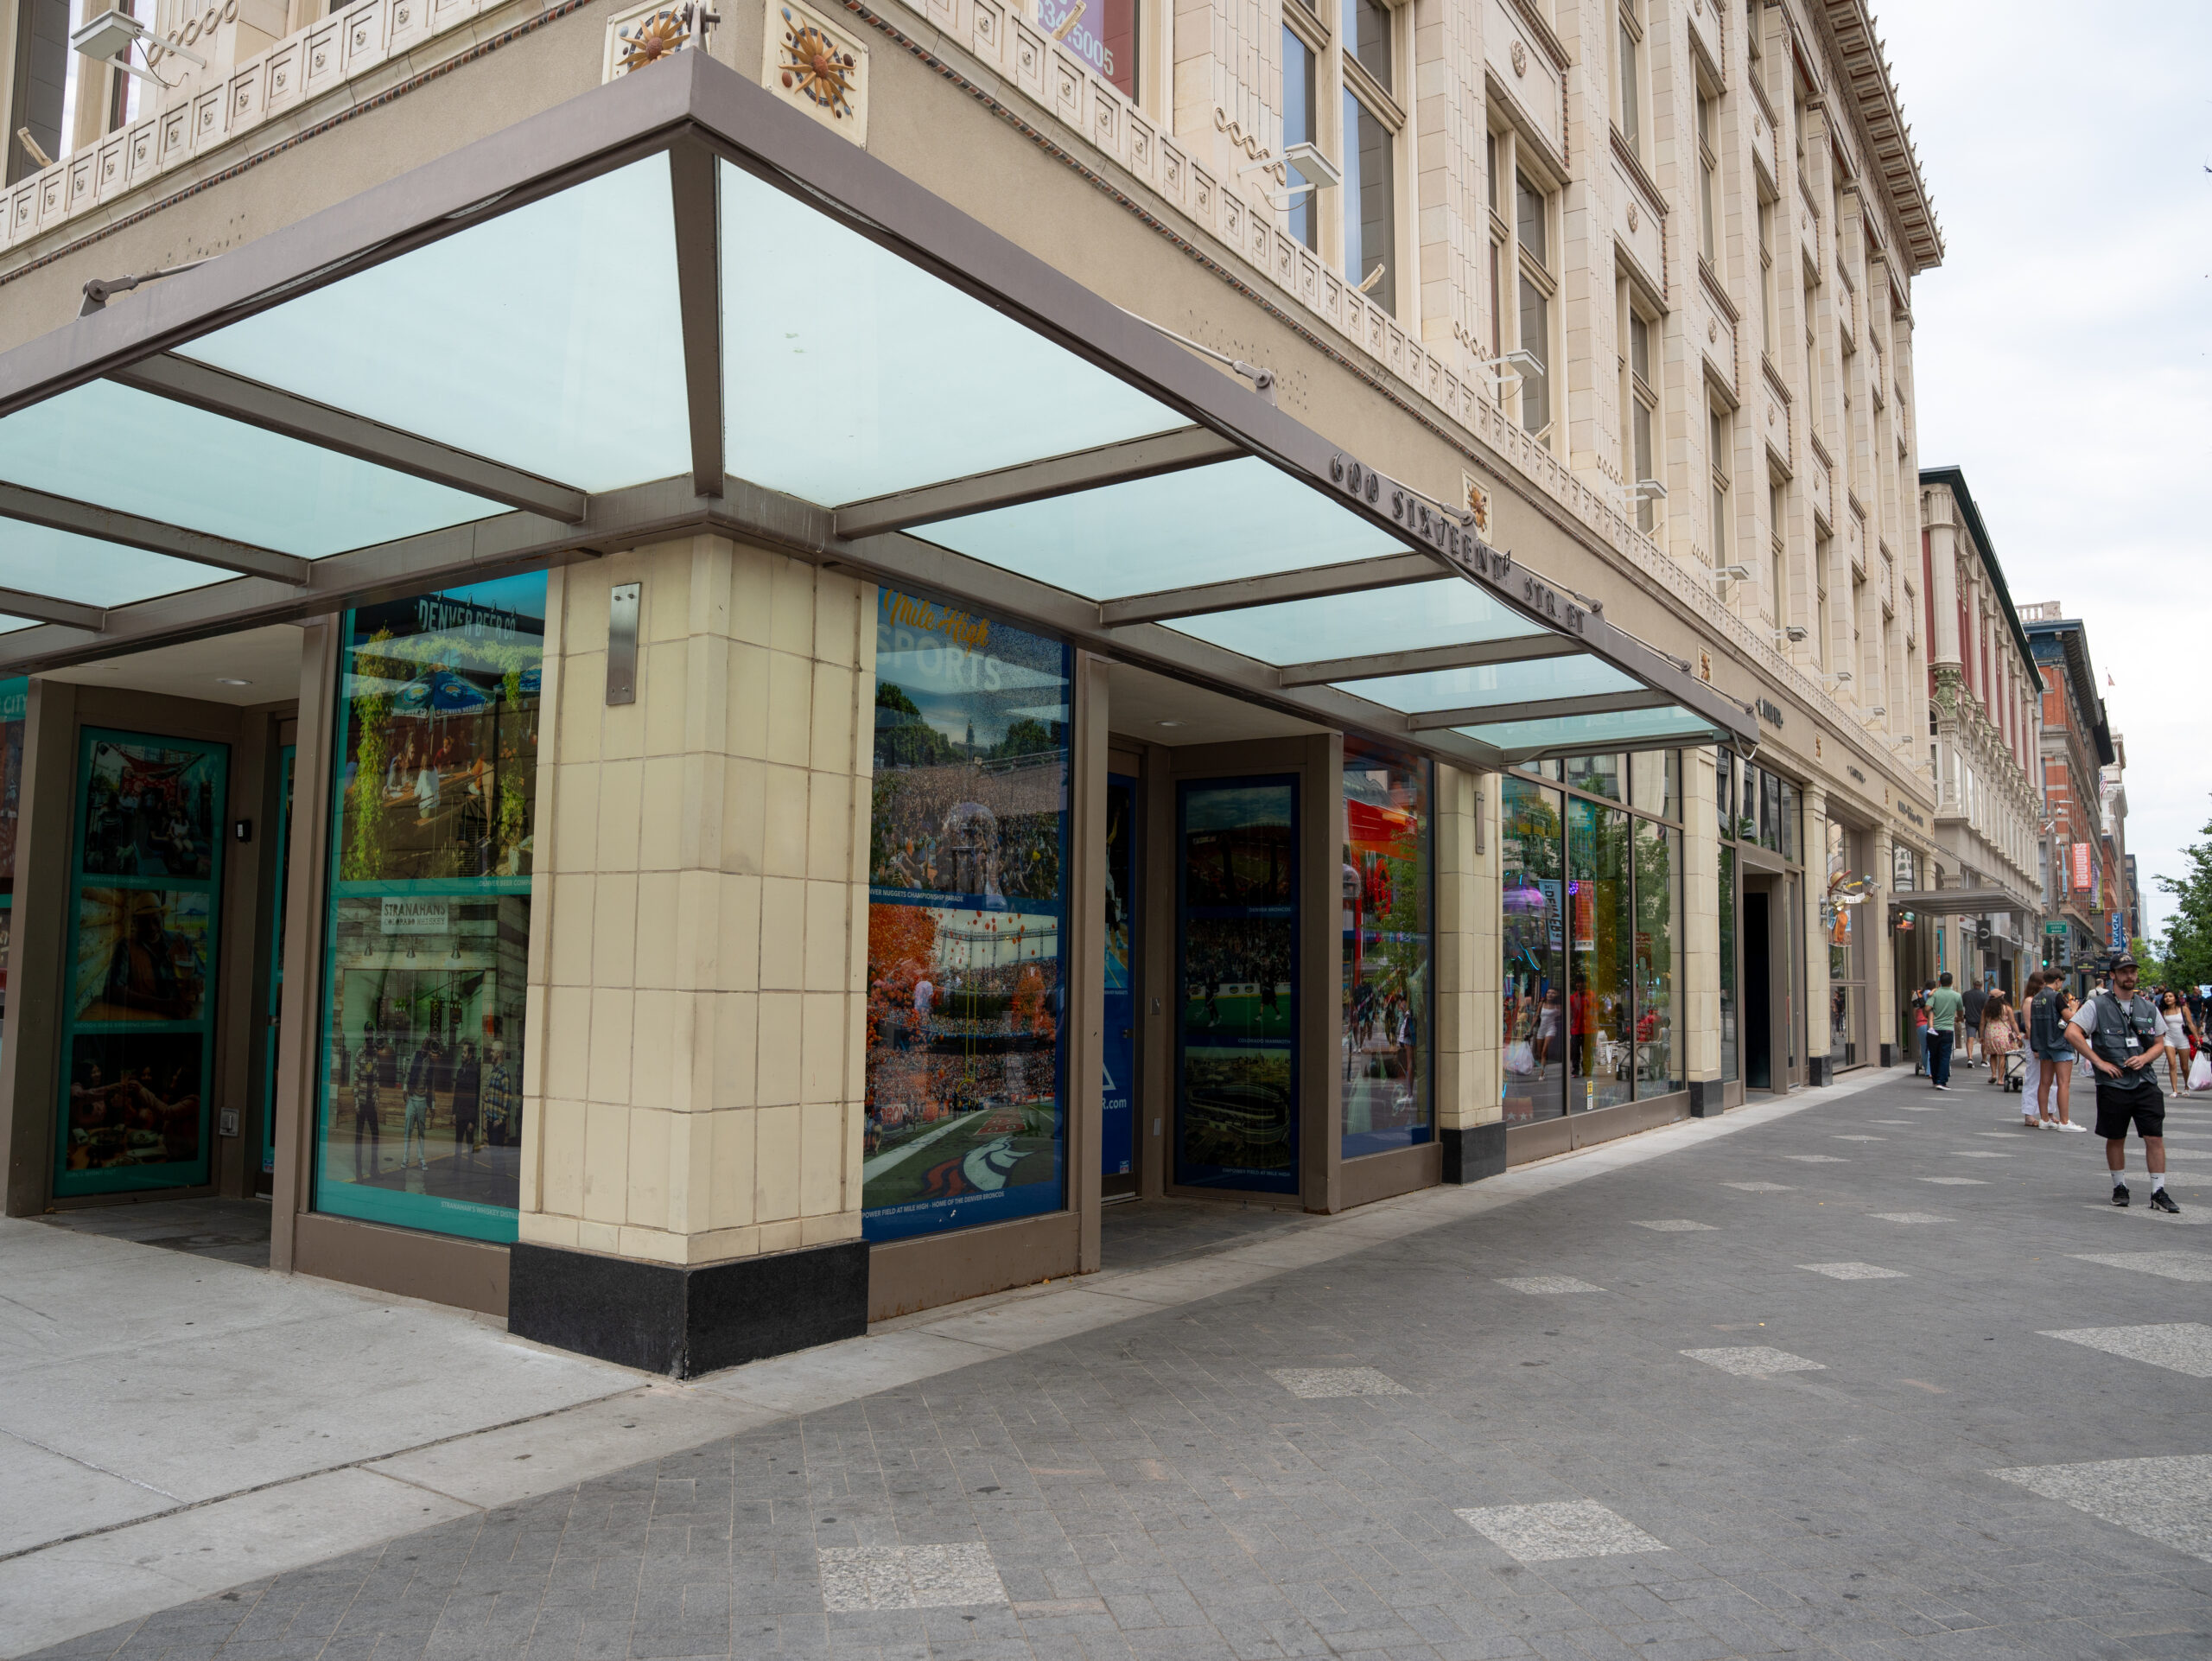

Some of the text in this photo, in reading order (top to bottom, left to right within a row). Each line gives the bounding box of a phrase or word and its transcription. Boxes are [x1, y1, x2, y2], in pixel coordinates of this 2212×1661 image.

[1332, 452, 1380, 503] 600
[418, 599, 473, 637] DENVER
[884, 589, 990, 657] Mile High
[876, 622, 1002, 691] SPORTS
[883, 889, 906, 898] NUGGETS
[906, 891, 945, 901] CHAMPIONSHIP
[384, 903, 446, 917] STRANAHANS
[416, 917, 445, 926] WHISKEY
[441, 1201, 476, 1213] STRANAHAN'S
[476, 1206, 499, 1216] WHISKEY
[904, 1205, 916, 1213] MILE
[916, 1202, 929, 1211] HIGH
[932, 1200, 947, 1209] HOME
[955, 1197, 964, 1206] THE
[964, 1193, 982, 1203] DENVER
[982, 1191, 1005, 1200] BRONCOS
